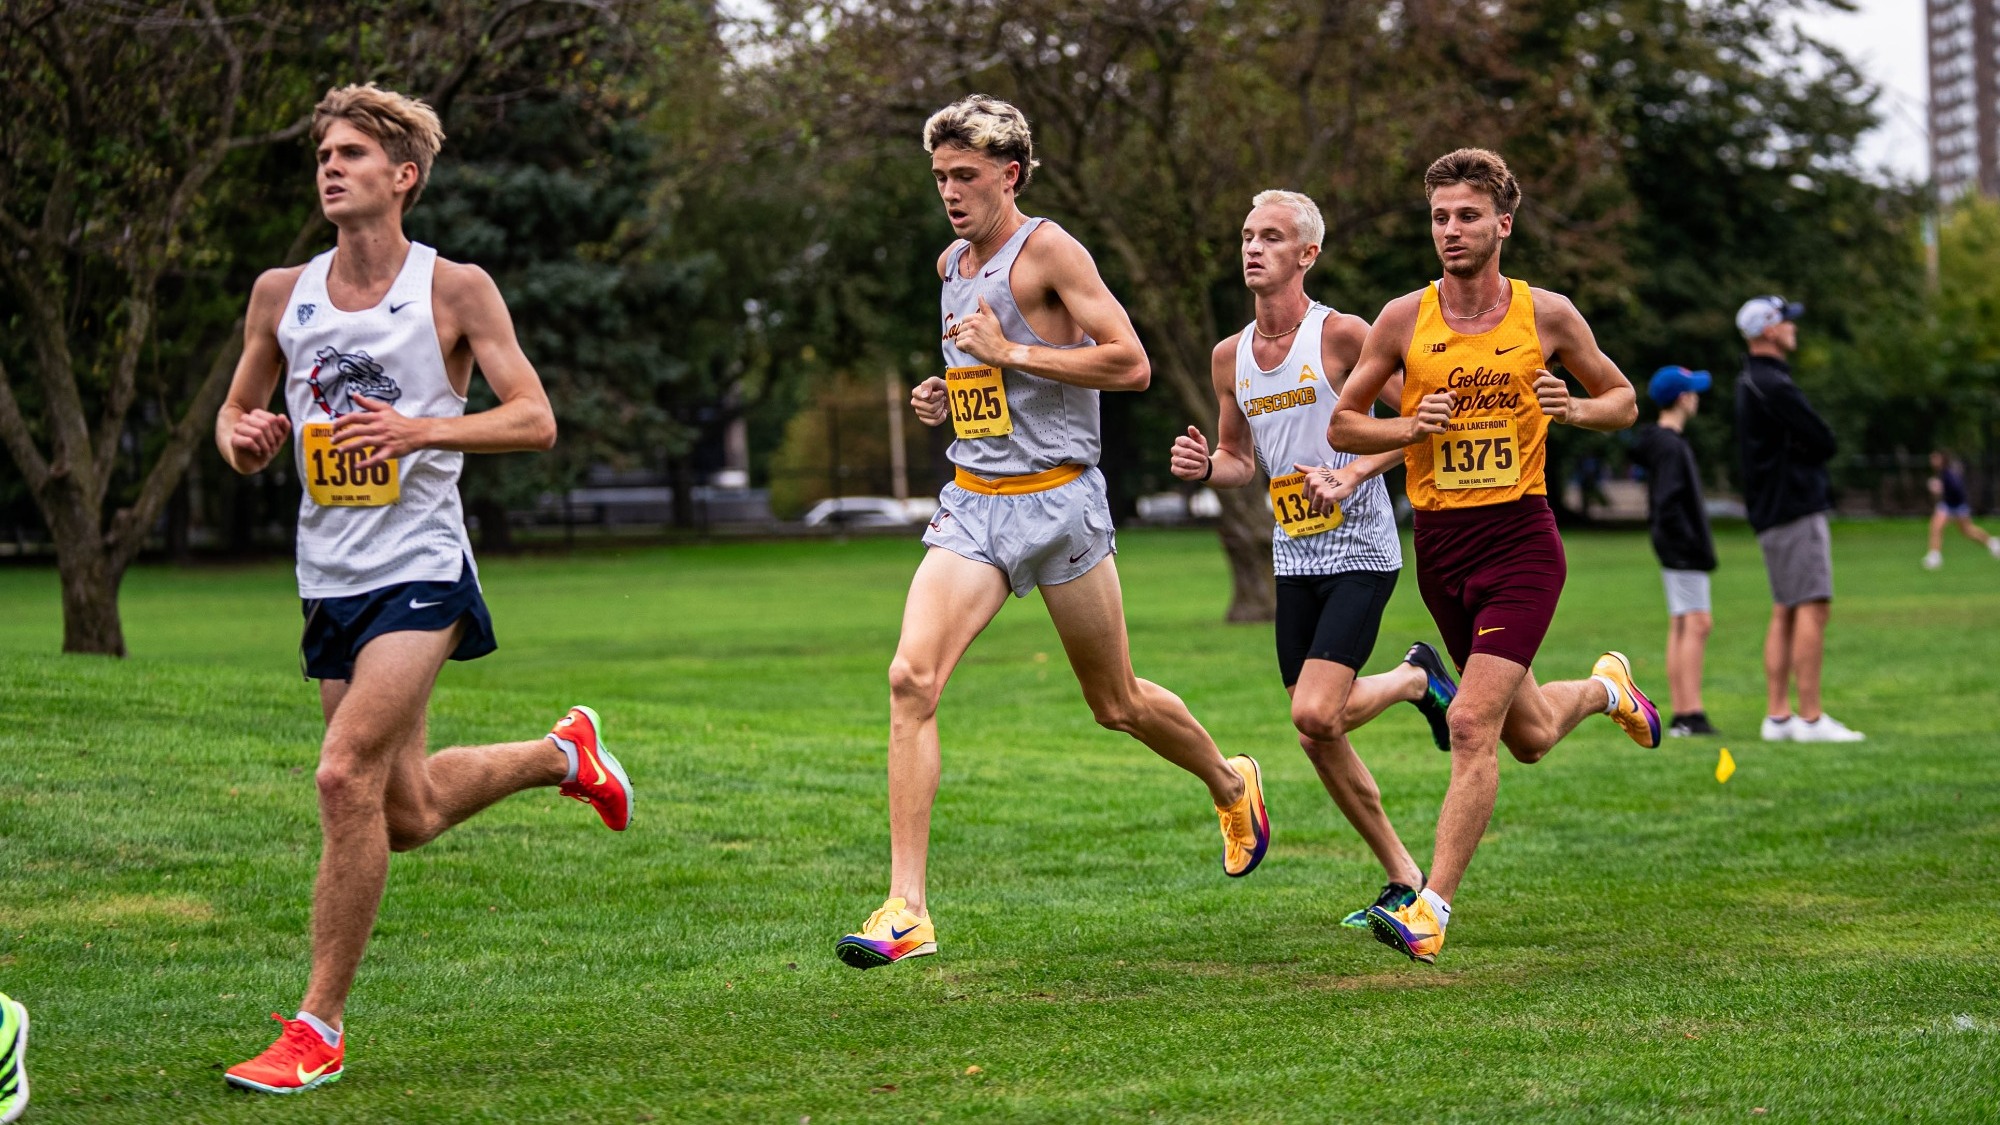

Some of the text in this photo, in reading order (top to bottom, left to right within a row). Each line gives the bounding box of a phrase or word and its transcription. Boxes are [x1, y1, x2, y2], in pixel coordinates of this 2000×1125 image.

[962, 369, 993, 379] LAKEFRONT
[1448, 366, 1511, 388] Golden
[952, 386, 1002, 422] 1325
[1244, 386, 1317, 417] LIPSCOMB
[1434, 387, 1520, 417] ophers
[1467, 420, 1508, 431] LAKEFRONT
[1441, 437, 1513, 473] 1375
[1272, 479, 1291, 489] LOYOLA
